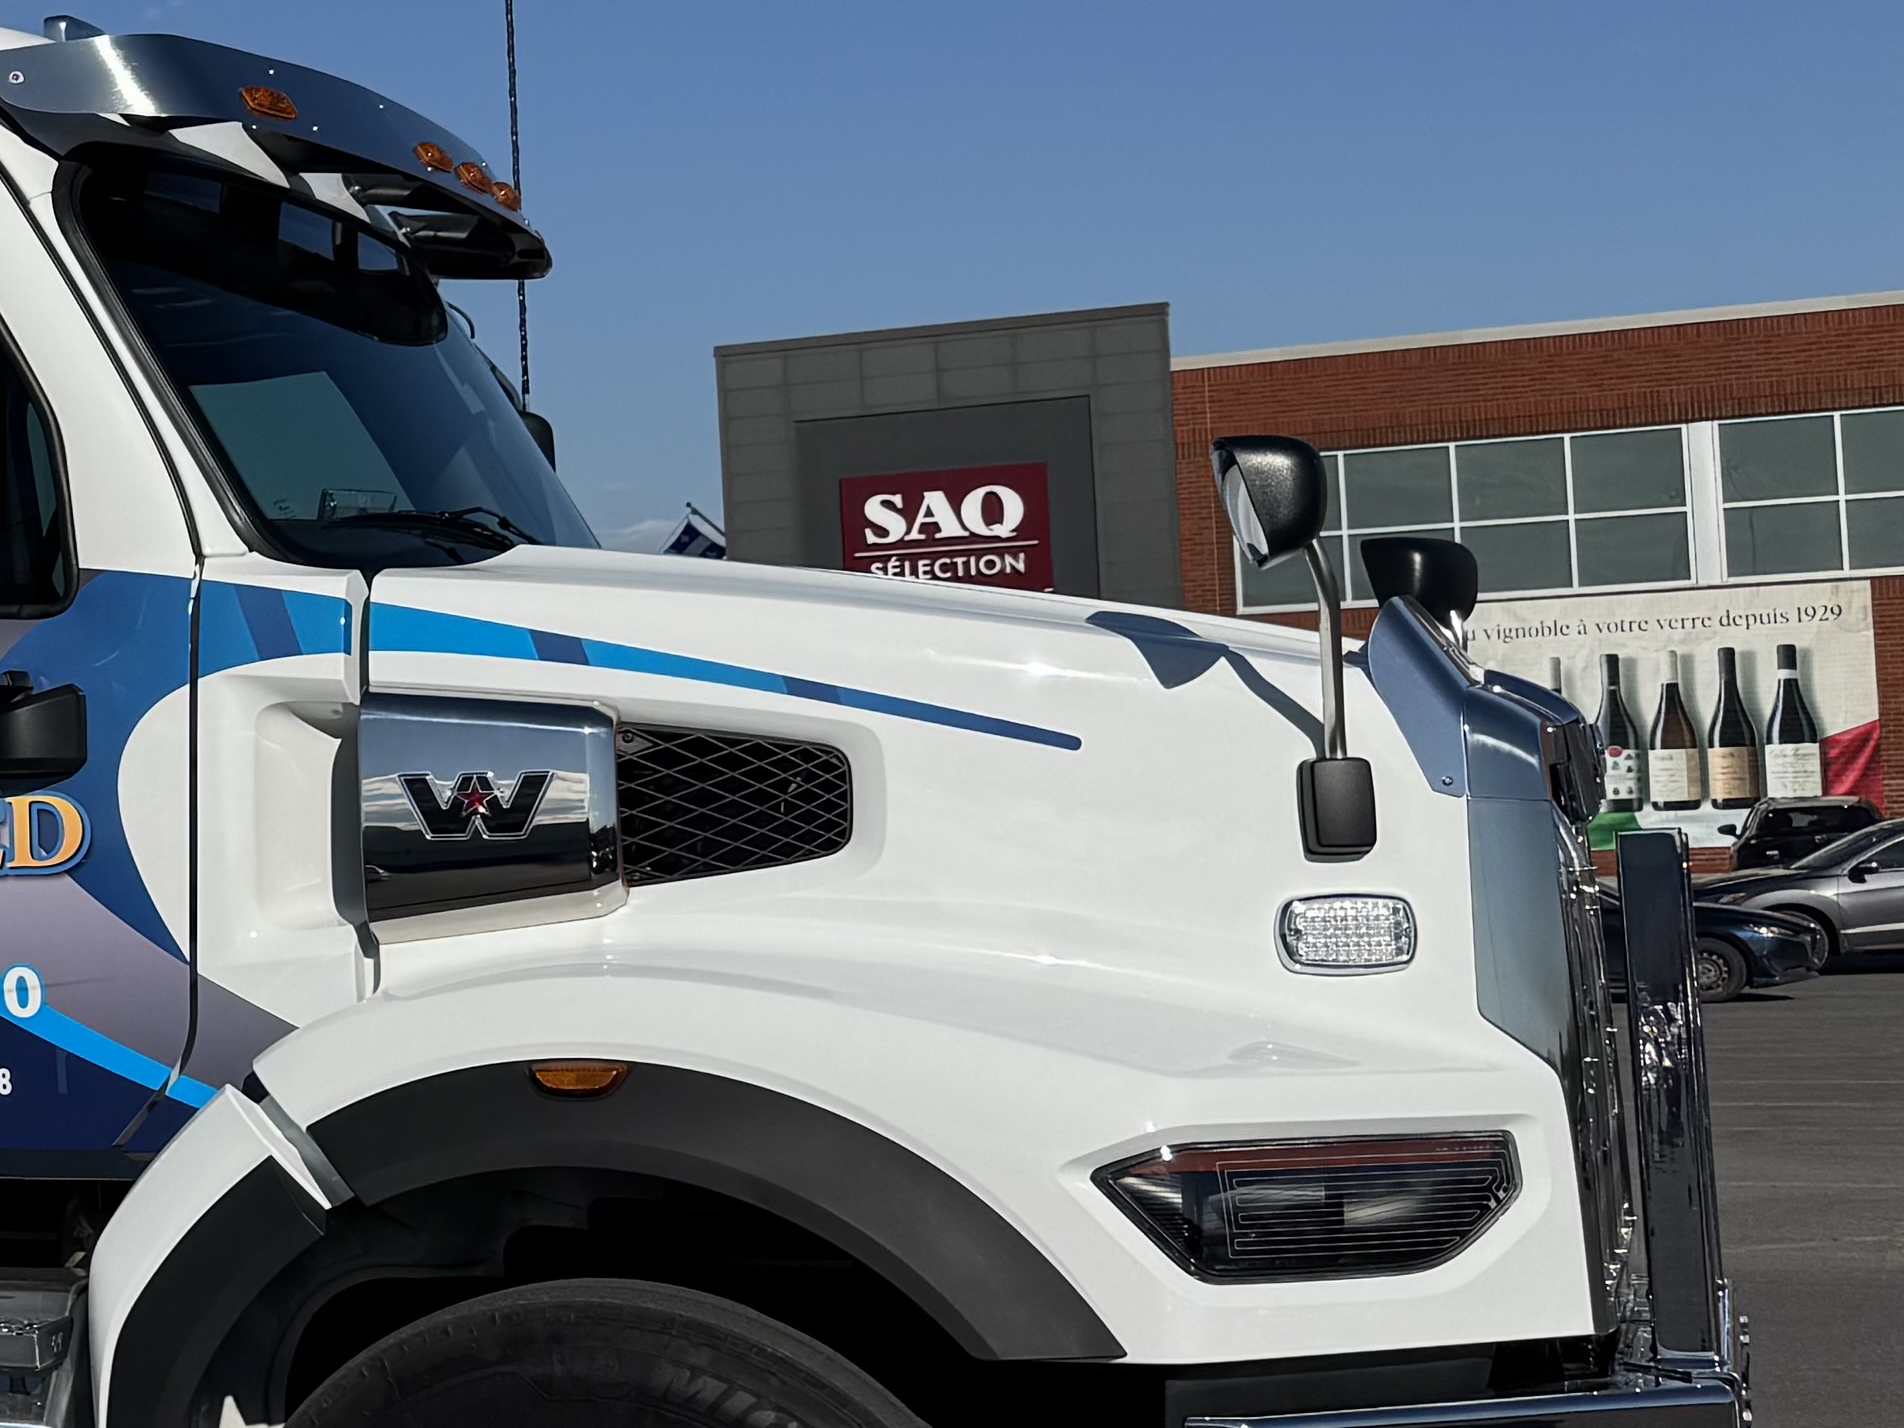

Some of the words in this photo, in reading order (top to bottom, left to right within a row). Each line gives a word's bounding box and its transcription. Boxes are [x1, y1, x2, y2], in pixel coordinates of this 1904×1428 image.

[864, 485, 1024, 545] SAQ
[870, 553, 1025, 580] SÉLECTION
[1483, 619, 1570, 644] vignoble
[1577, 618, 1587, 636] à
[1595, 619, 1649, 634] votre
[1656, 615, 1712, 630] verre
[1719, 608, 1789, 630] depuis
[1797, 603, 1843, 623] 1929
